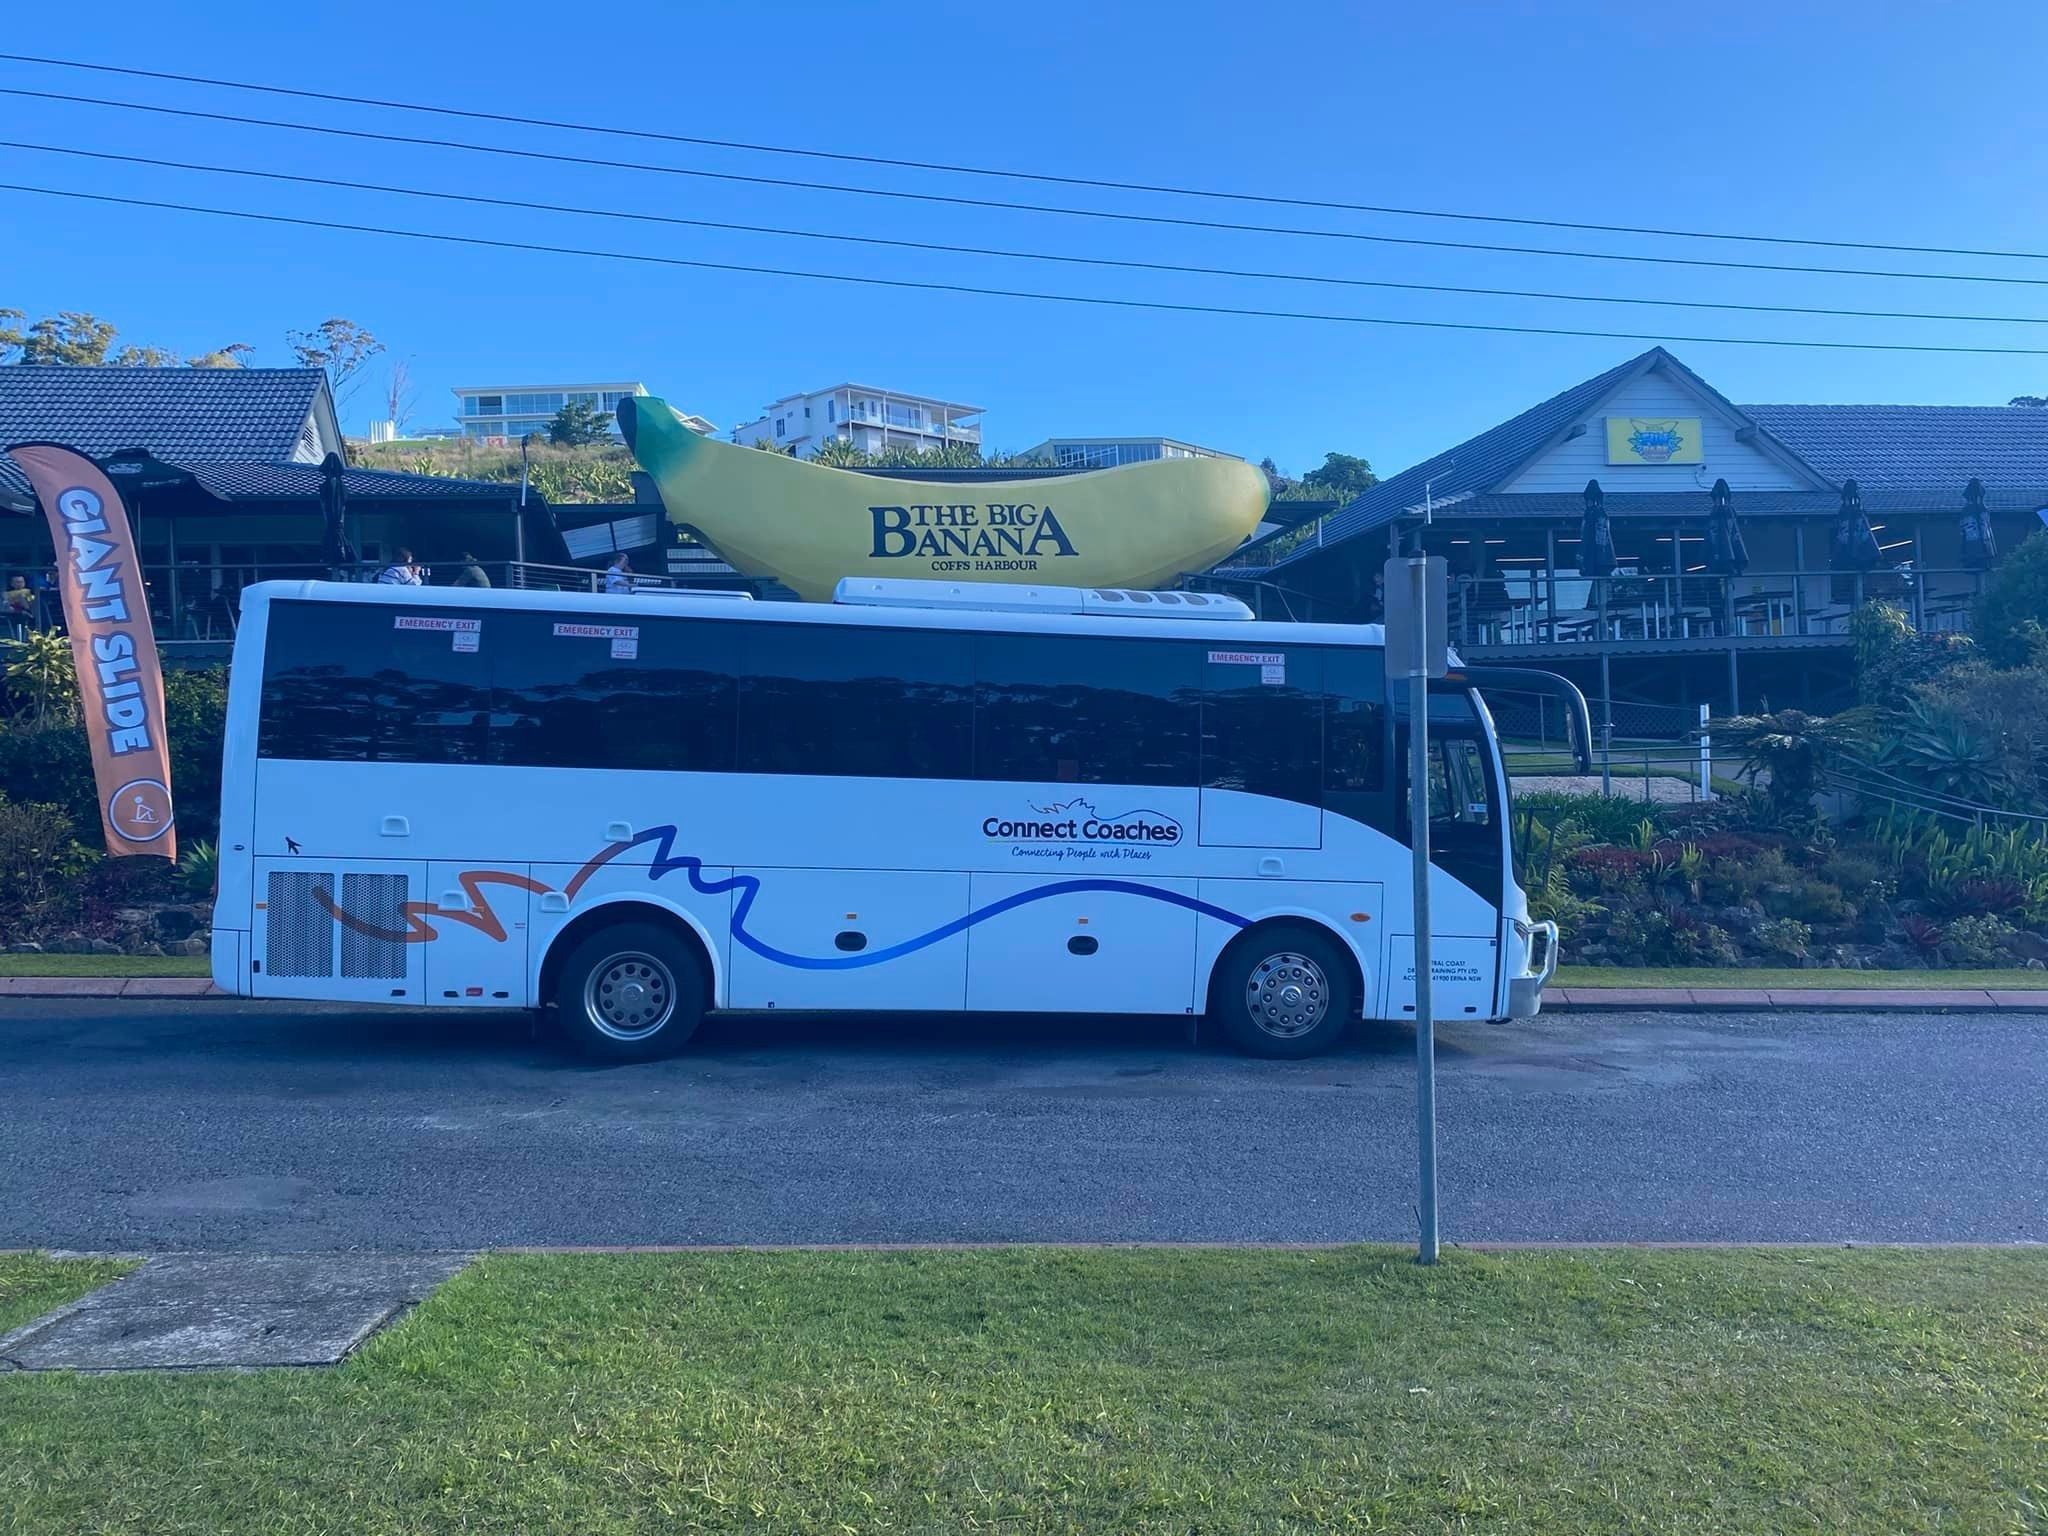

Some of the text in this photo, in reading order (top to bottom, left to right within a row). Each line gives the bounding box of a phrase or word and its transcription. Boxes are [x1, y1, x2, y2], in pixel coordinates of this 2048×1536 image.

[910, 504, 1038, 526] THE BIG
[868, 506, 1080, 557] BANANA
[58, 487, 130, 622] GIANT
[931, 560, 1038, 571] COFFS HARBOUR
[399, 618, 476, 630] EMERGENCY EXIT
[558, 625, 634, 637] EMERGENCY EXIT
[1211, 653, 1280, 663] EMERGENCY EXIT
[93, 633, 151, 754] SLIDE
[982, 817, 1178, 841] Connect Coaches
[1011, 846, 1152, 861] Connecting People with Places
